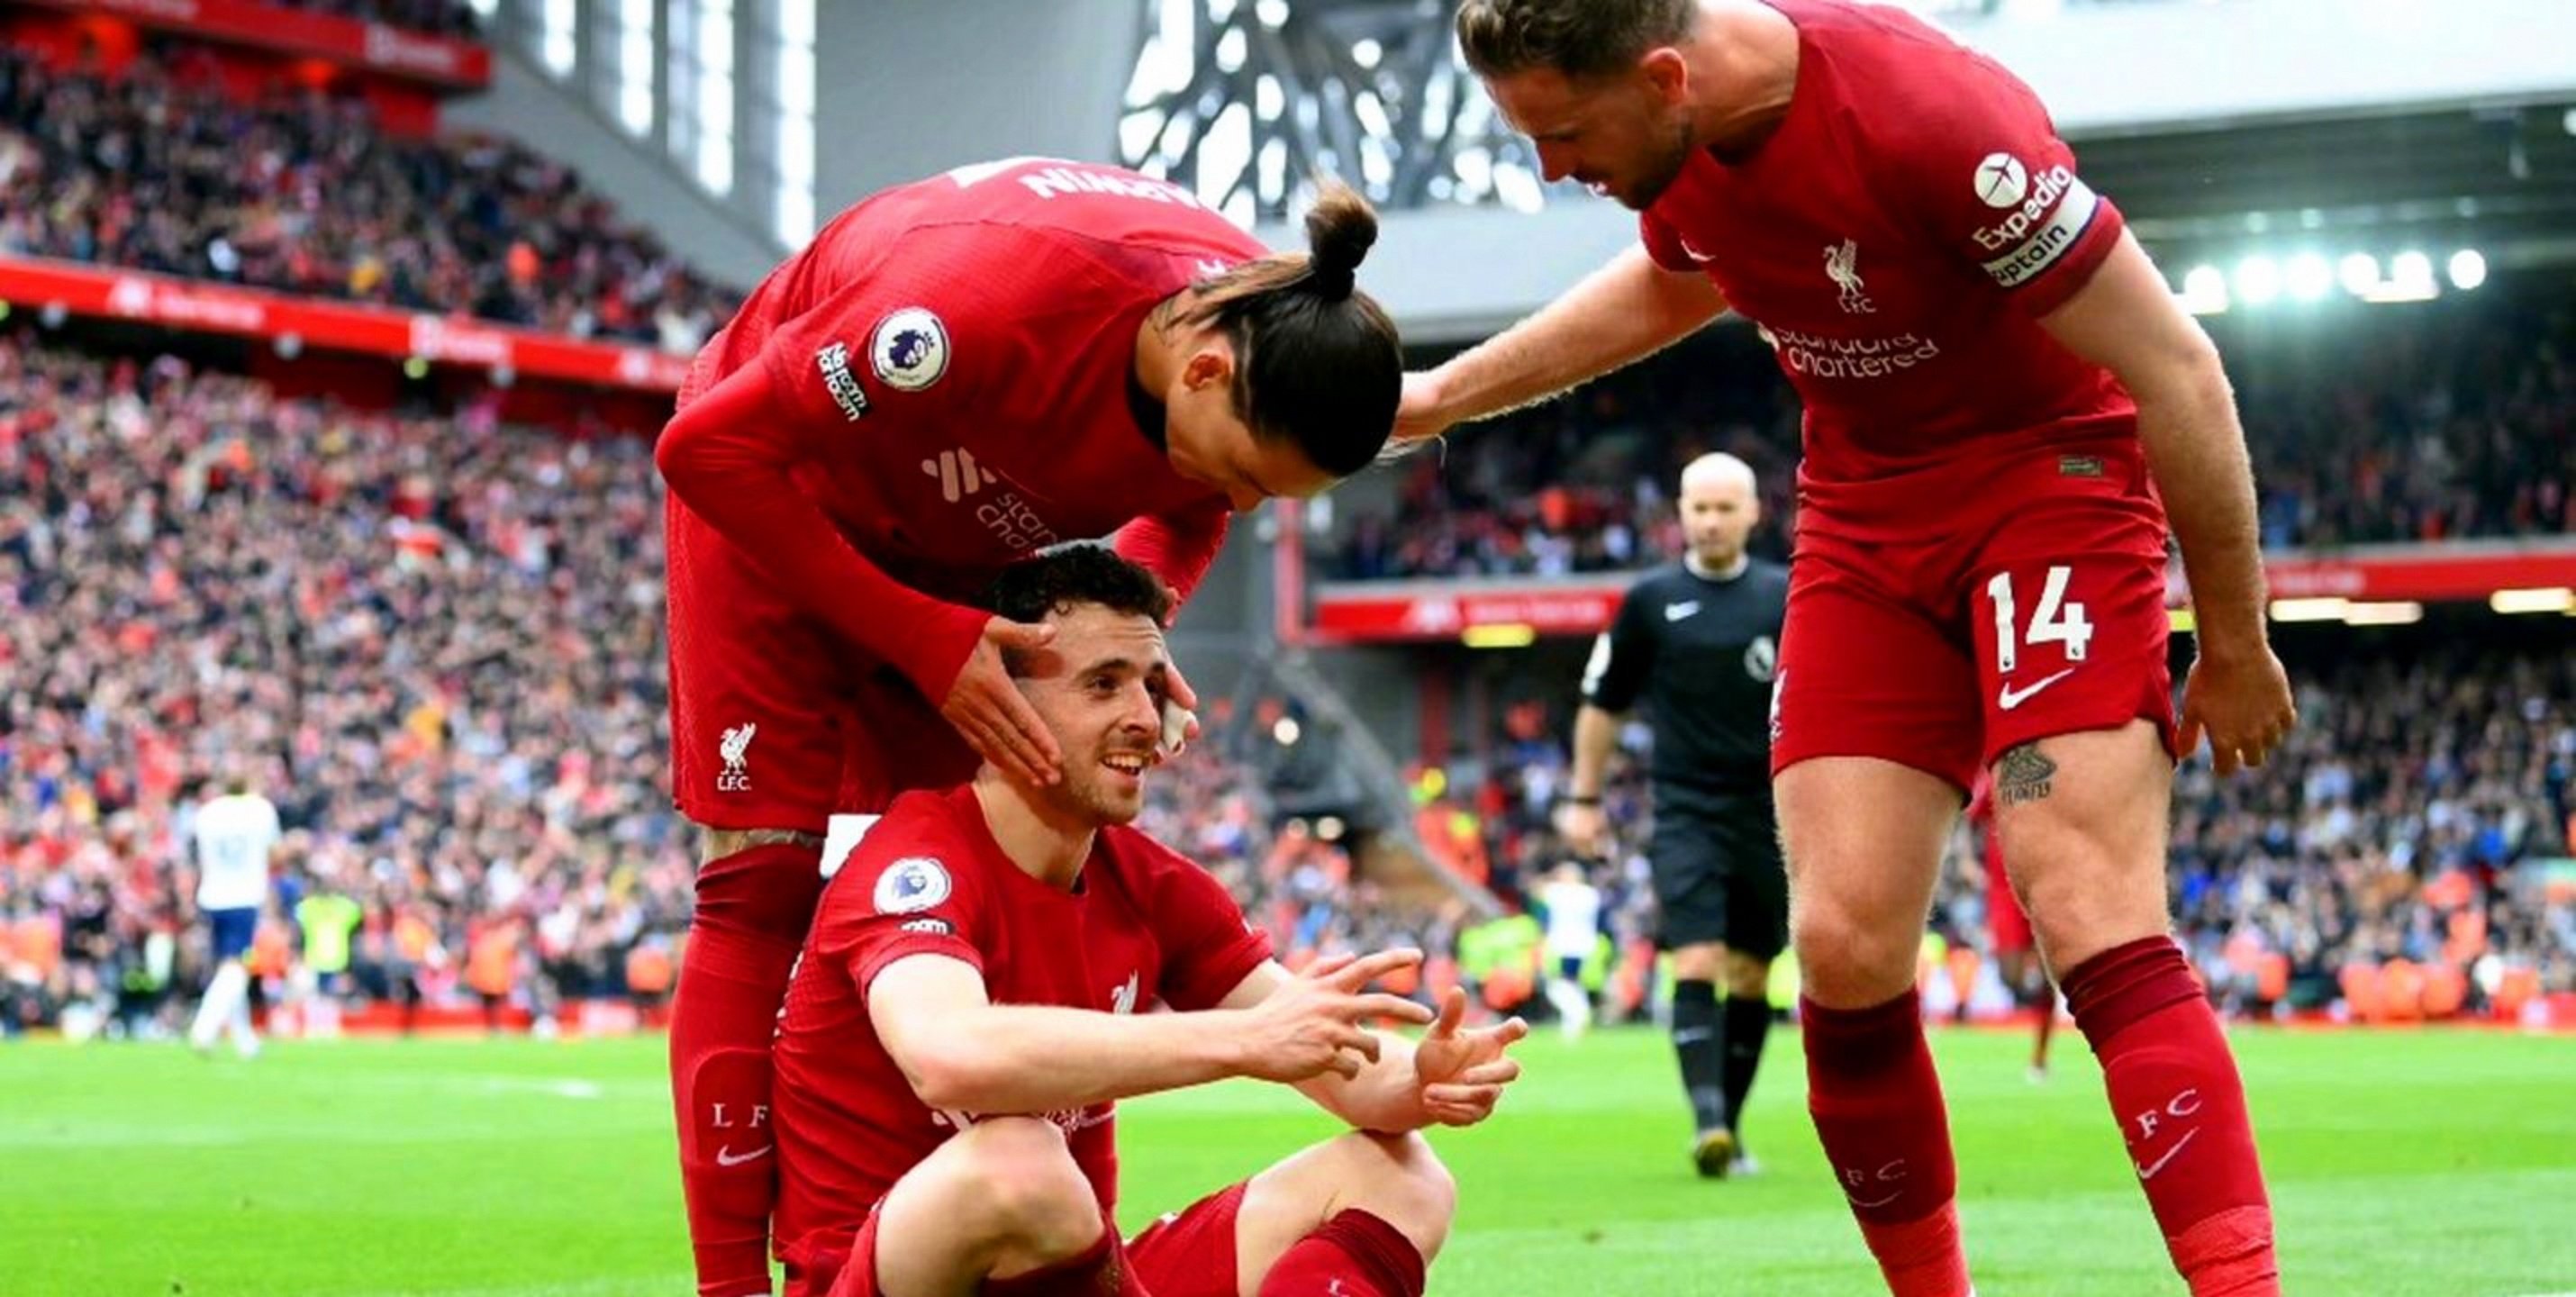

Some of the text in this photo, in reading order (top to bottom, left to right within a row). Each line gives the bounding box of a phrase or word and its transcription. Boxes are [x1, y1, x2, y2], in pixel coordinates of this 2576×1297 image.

[1972, 164, 2072, 250] Expedia
[1992, 224, 2068, 282] aptain
[1788, 339, 1940, 378] chartered
[1987, 566, 2094, 674] 14
